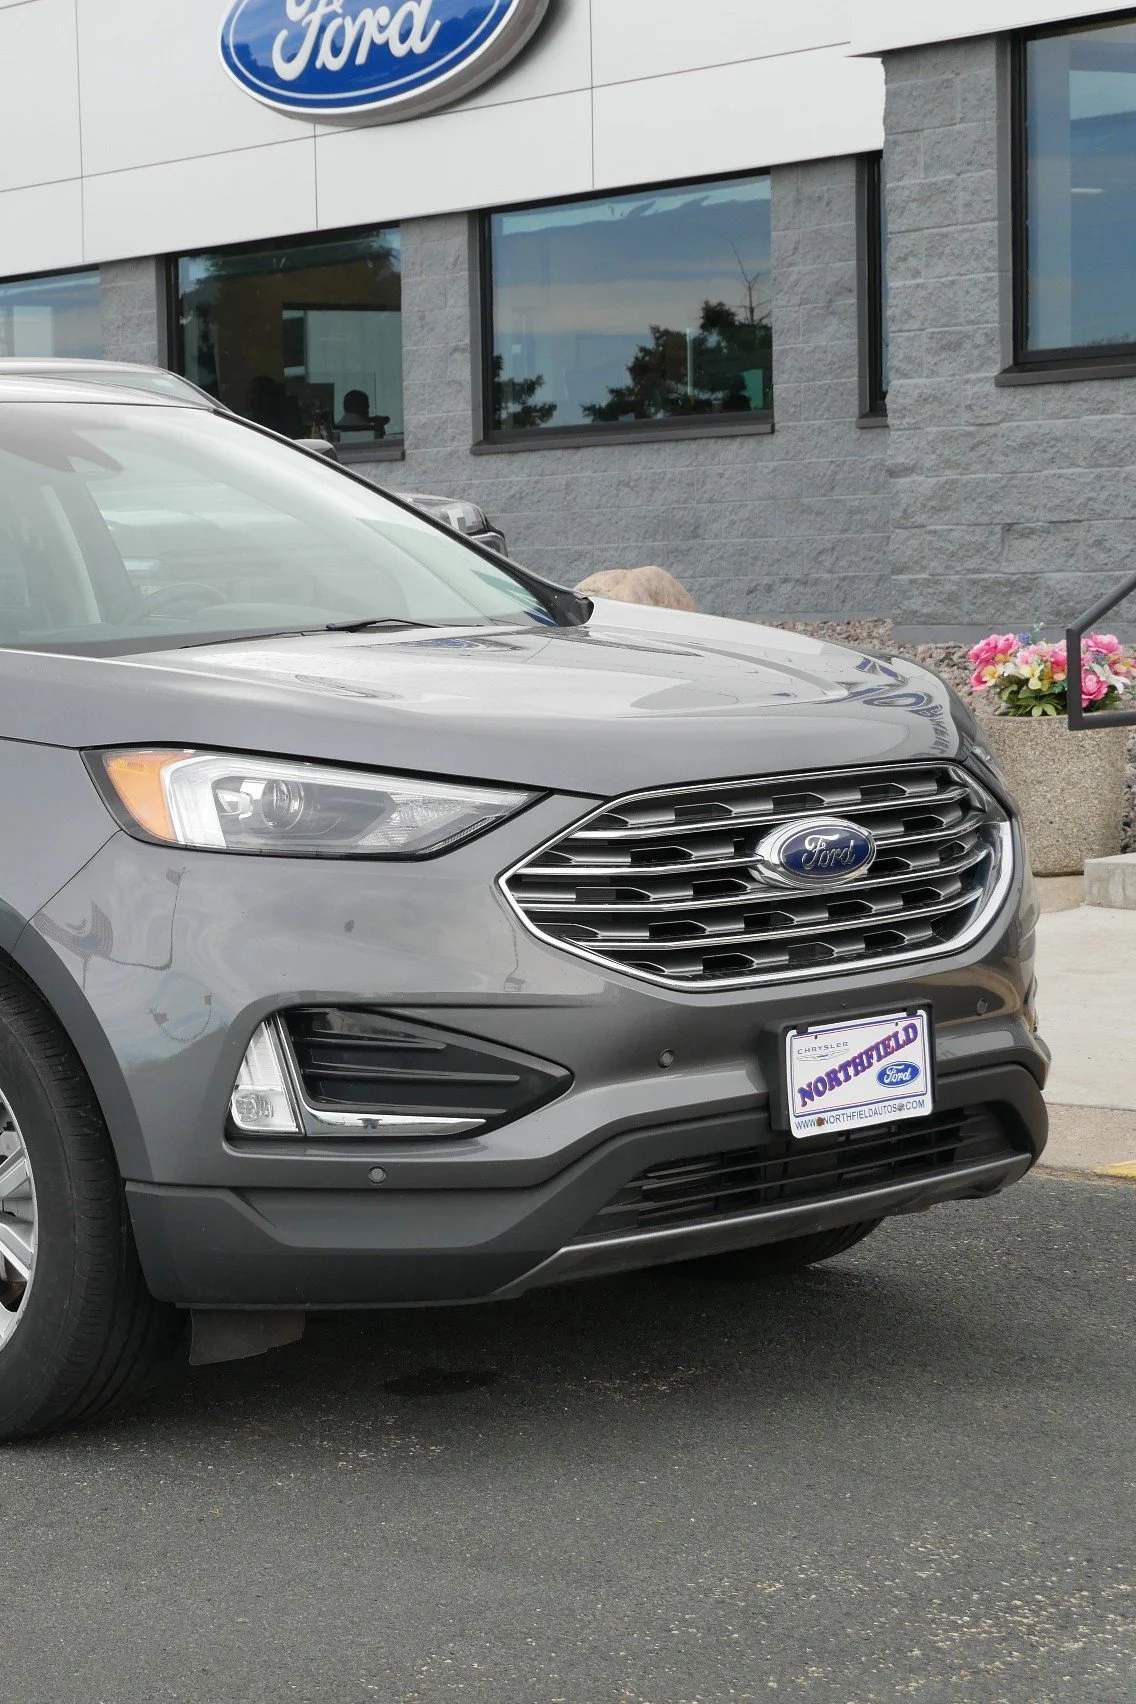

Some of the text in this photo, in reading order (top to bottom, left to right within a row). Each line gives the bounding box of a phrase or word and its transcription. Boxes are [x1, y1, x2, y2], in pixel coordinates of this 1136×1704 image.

[272, 0, 441, 81] Ford
[802, 833, 855, 870] Ford
[797, 1041, 849, 1055] CHRYSLER
[797, 1022, 919, 1108] NORTHFIELD
[883, 1065, 911, 1083] Ford
[794, 1099, 925, 1131] WWWNORTHFIELDAUTOS.COM
